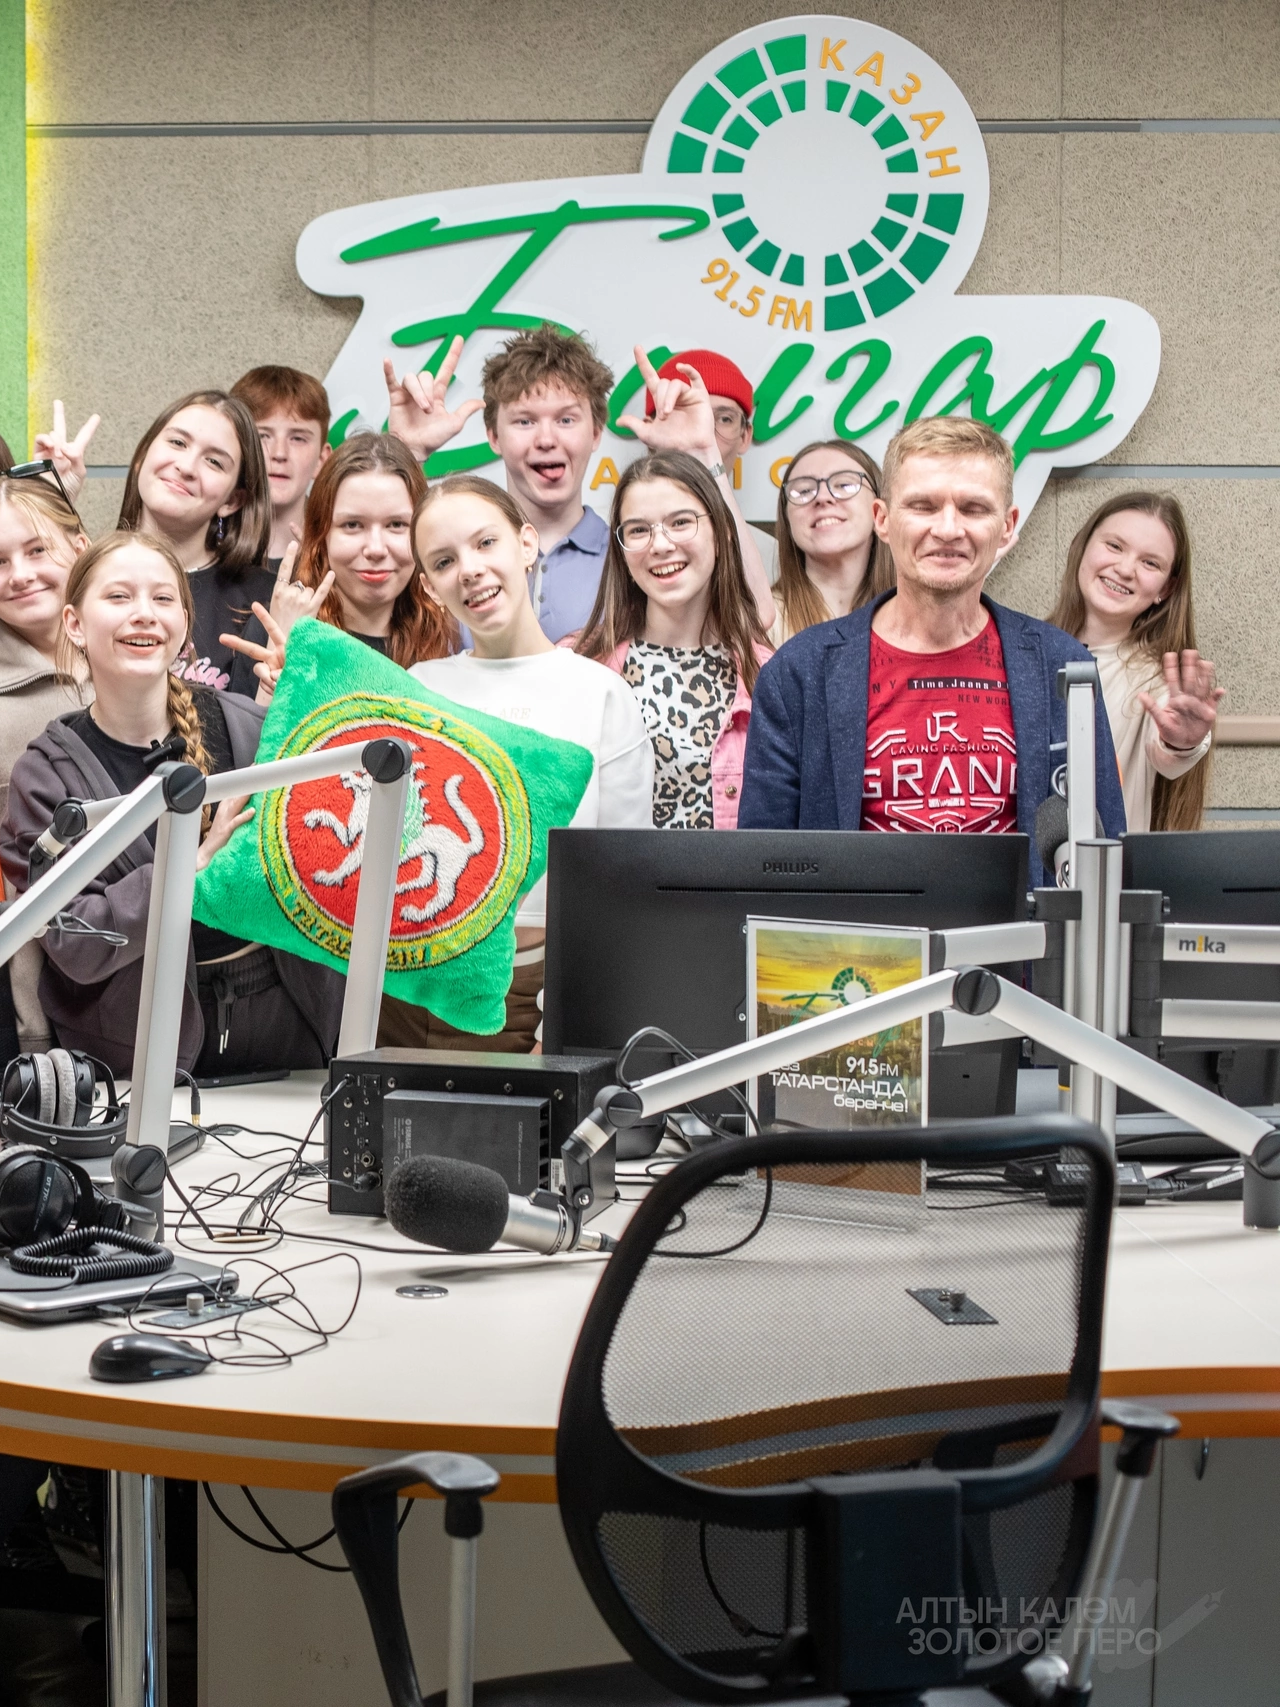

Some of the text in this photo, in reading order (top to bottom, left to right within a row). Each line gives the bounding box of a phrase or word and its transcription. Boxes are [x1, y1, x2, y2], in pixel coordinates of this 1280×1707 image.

[820, 37, 961, 178] КАЗАН
[701, 258, 813, 332] 91.5 FM
[958, 694, 980, 703] NEW
[890, 743, 999, 756] LAVING FASHION
[762, 861, 819, 875] PHILIPS
[879, 1062, 899, 1077] FM
[769, 1071, 907, 1099] ТАТАРСТАНДА
[833, 1093, 909, 1113] беренче!
